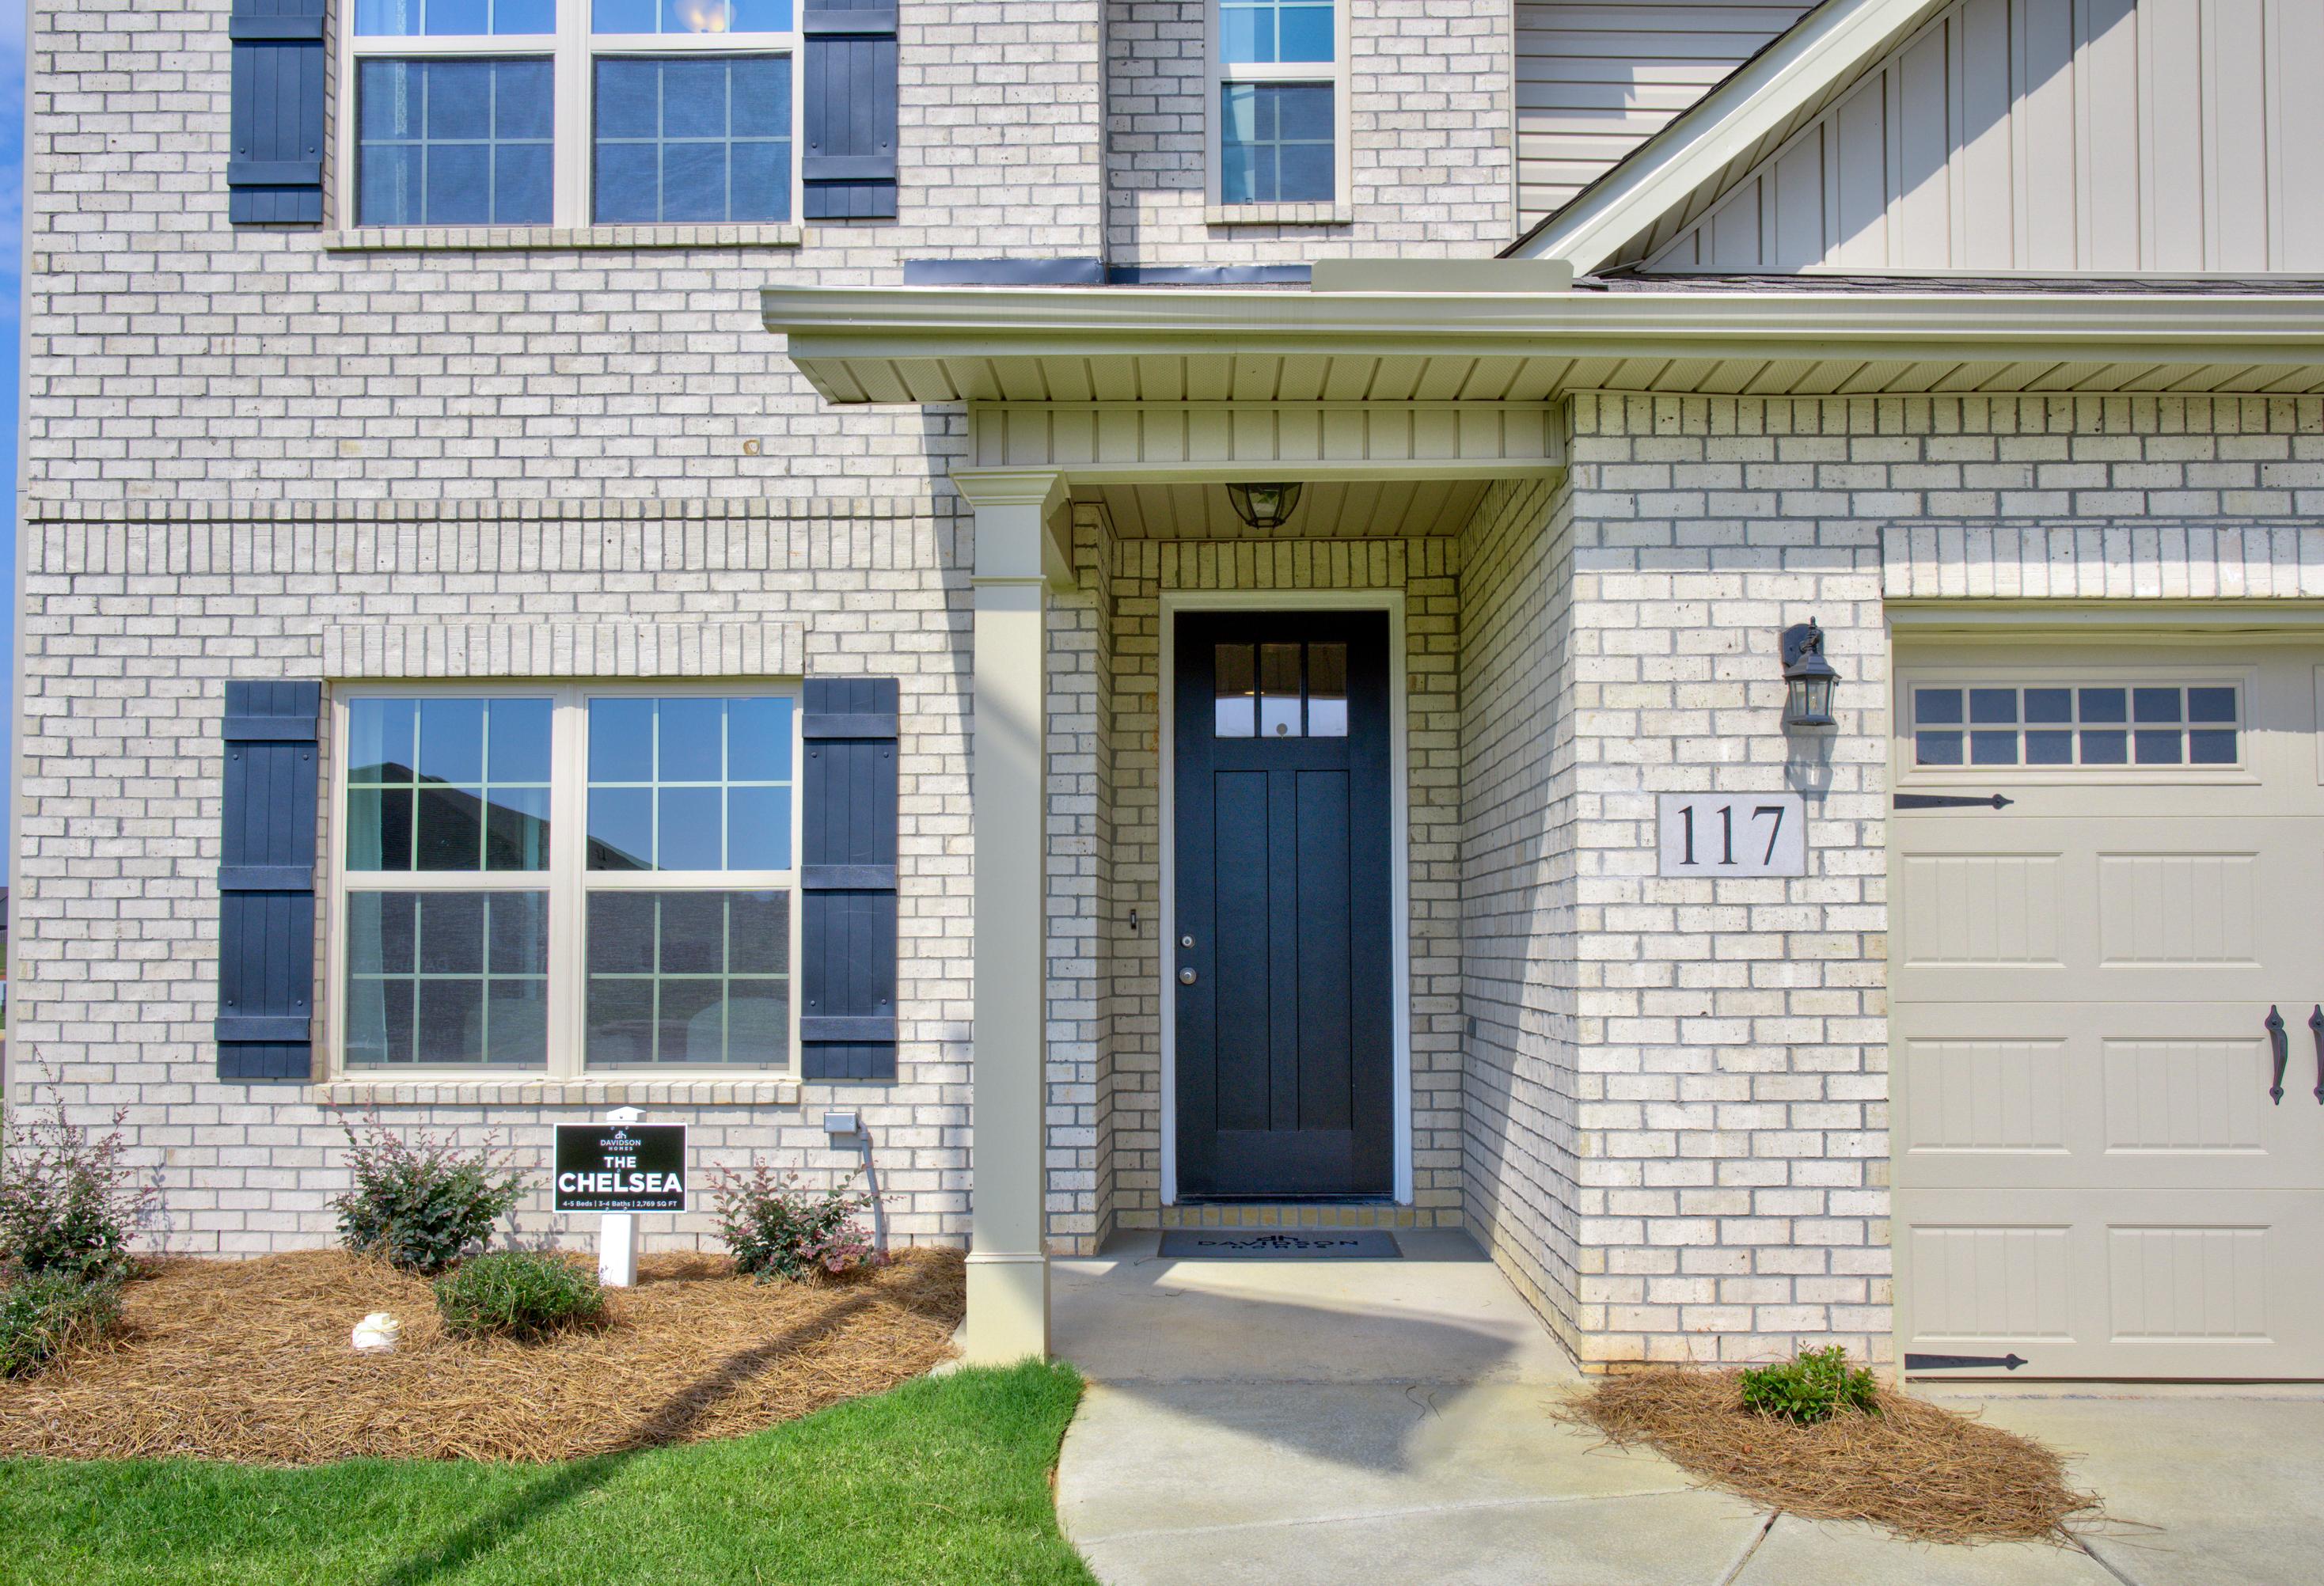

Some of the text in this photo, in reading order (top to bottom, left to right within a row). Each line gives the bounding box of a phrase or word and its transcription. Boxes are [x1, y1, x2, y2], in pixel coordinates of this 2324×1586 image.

[1677, 805, 1785, 866] 117
[603, 1156, 636, 1168] THE
[558, 1173, 683, 1193] CHELSEA
